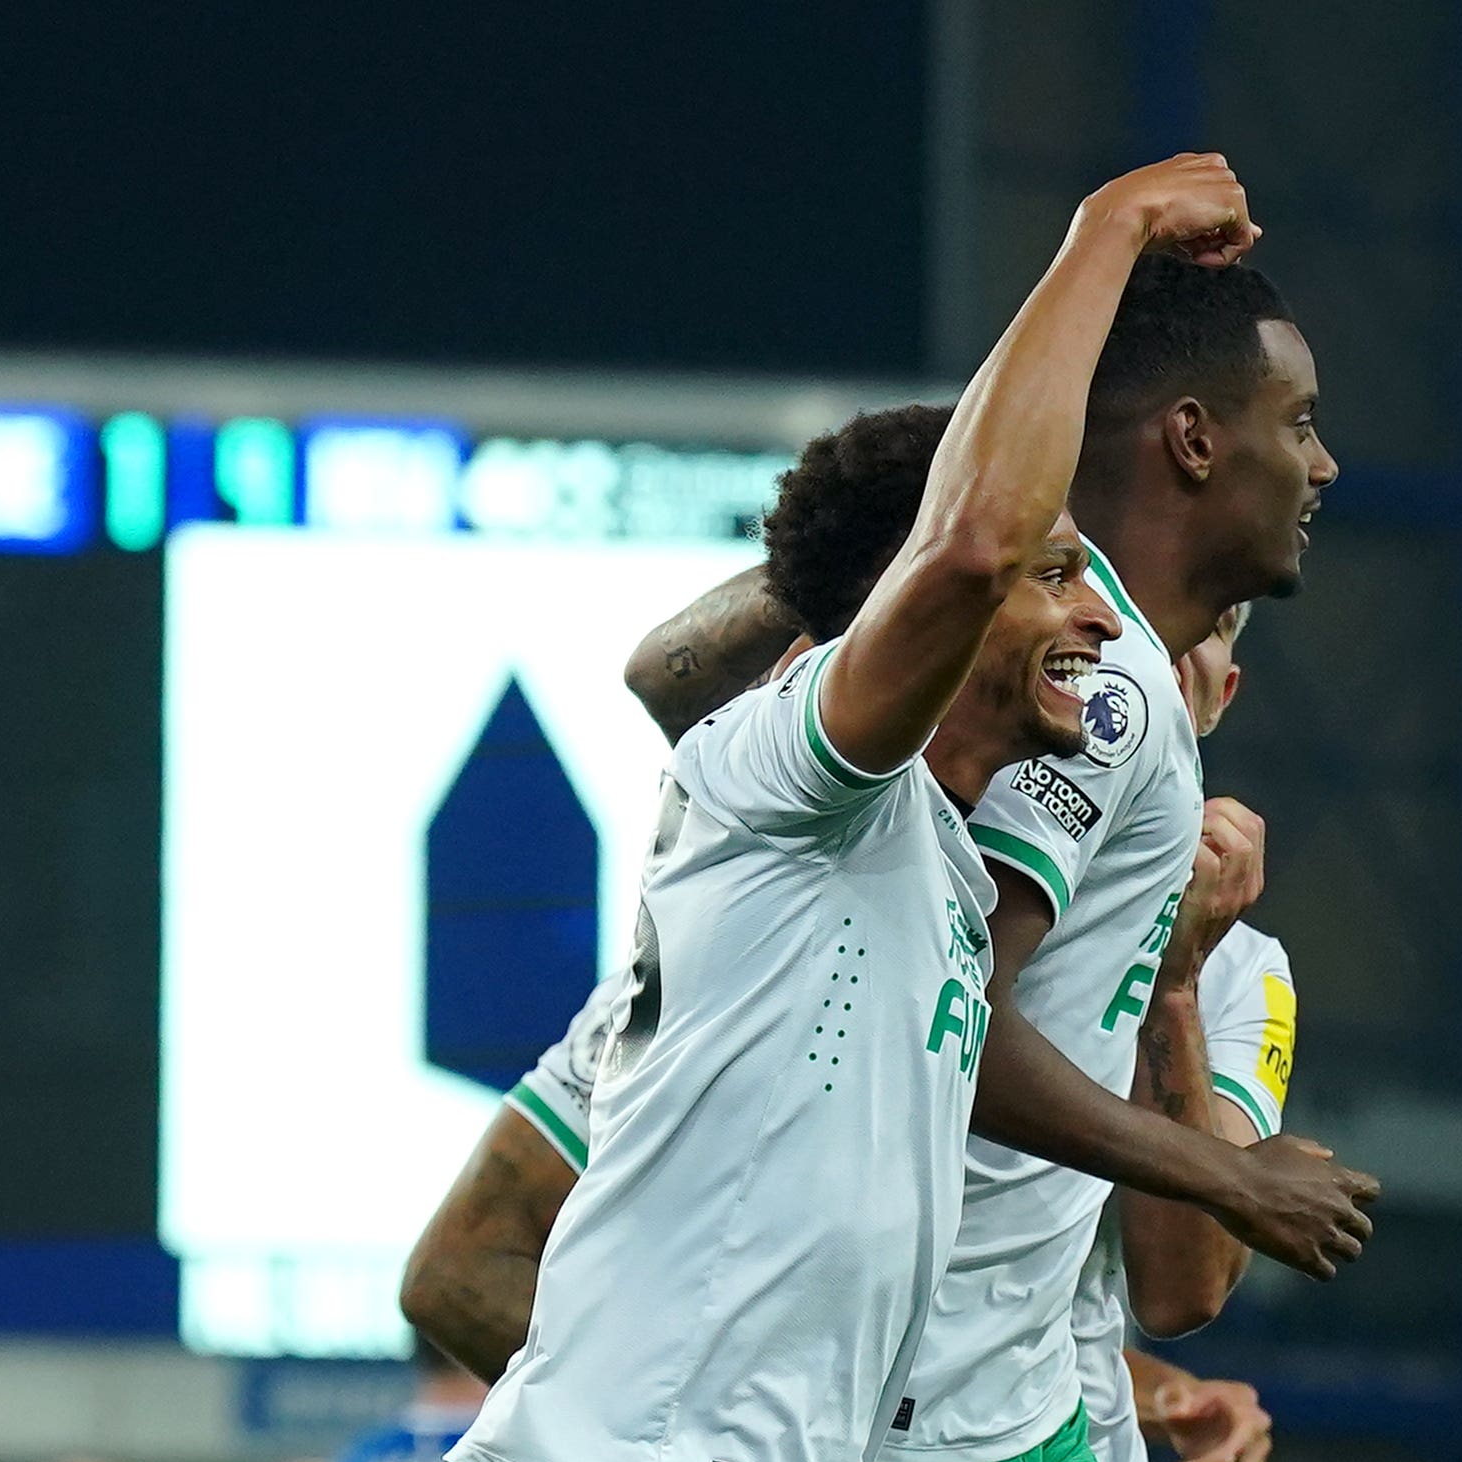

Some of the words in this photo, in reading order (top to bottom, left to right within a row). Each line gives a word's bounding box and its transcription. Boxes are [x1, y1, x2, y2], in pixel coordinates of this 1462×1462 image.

[1018, 759, 1052, 784] No
[1050, 777, 1093, 822] room
[1041, 791, 1087, 841] racism
